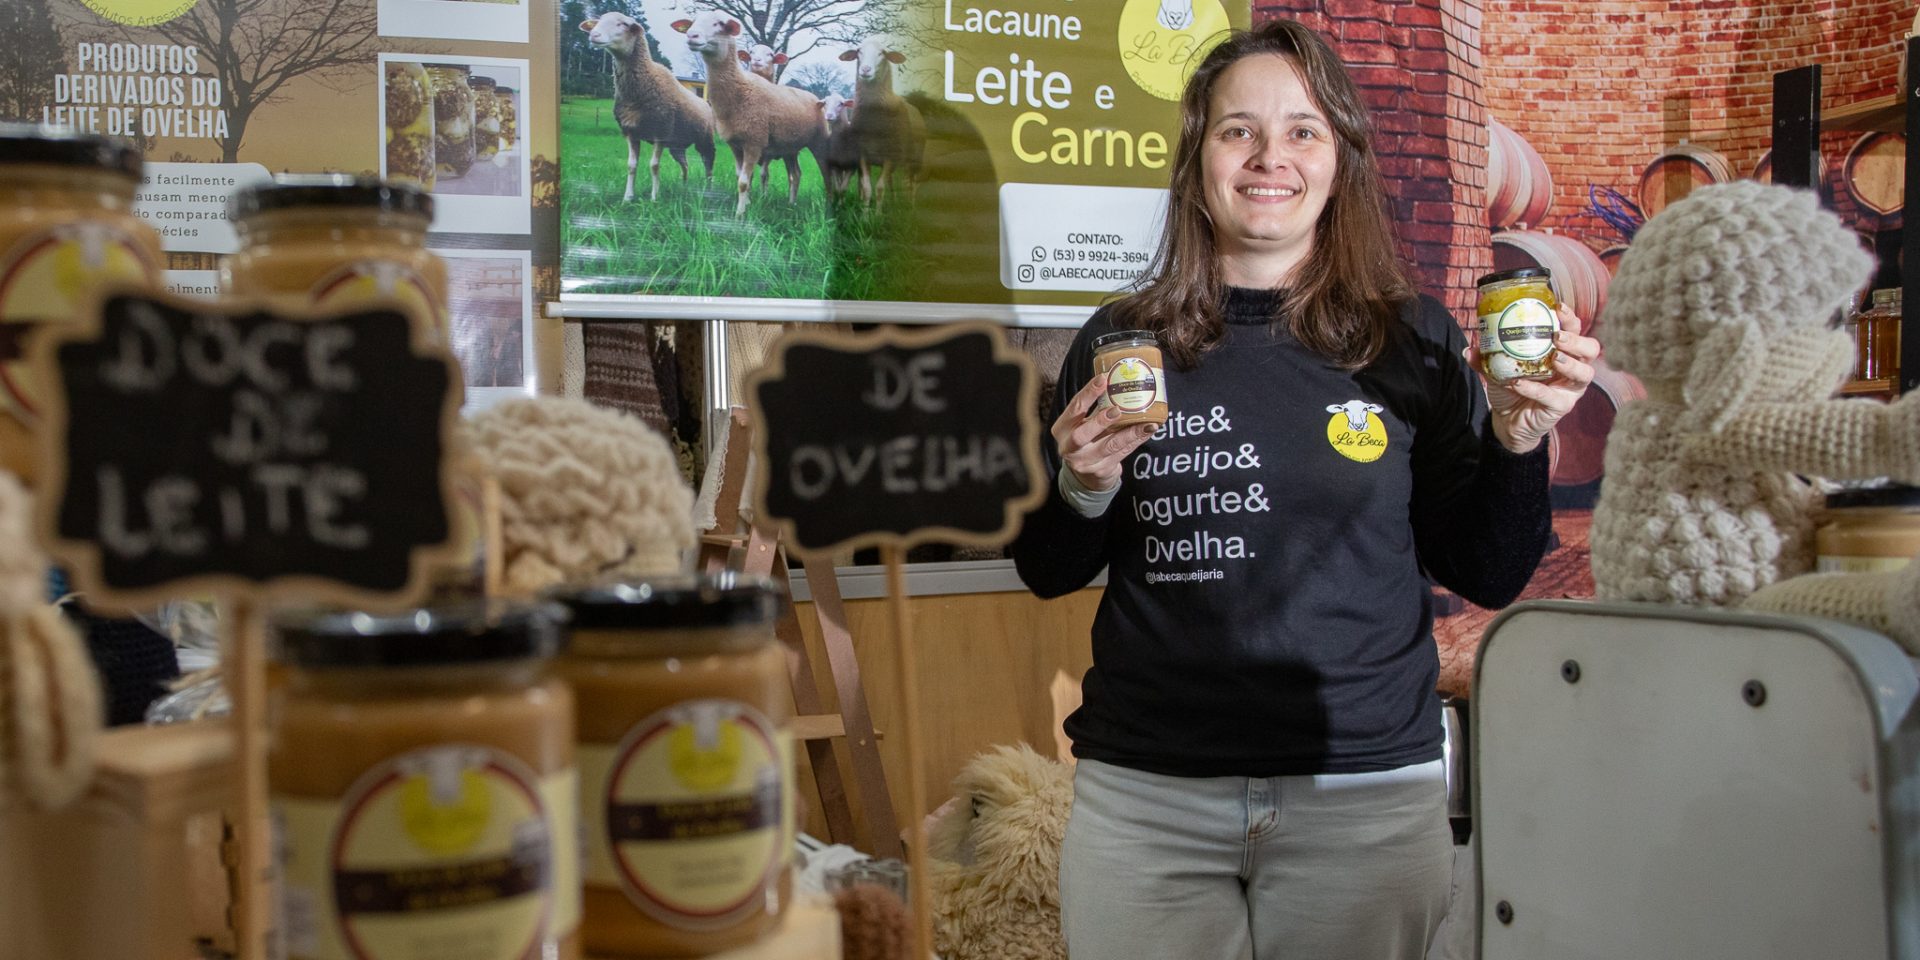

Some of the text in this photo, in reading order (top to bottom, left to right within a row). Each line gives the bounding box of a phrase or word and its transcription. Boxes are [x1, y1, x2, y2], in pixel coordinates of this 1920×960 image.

[944, 0, 1082, 40] Lacaune
[78, 42, 198, 75] PRODUTOS
[1123, 30, 1164, 63] La
[55, 74, 222, 107] DERIVADOS DO
[944, 50, 1115, 109] Leite e
[43, 105, 229, 138] LEITE DE OVELHA
[1011, 111, 1168, 169] Carne
[157, 174, 236, 186] facilmente
[136, 193, 182, 202] ausam
[133, 208, 228, 221] do comparad
[1053, 248, 1149, 263] (53) 9 9924-3694
[1067, 232, 1124, 246] CONTATO:
[104, 300, 358, 394] DOCE
[862, 350, 947, 412] DE
[212, 388, 328, 464] DE
[1151, 405, 1233, 441] eite&
[1332, 431, 1386, 447] La Beca
[788, 434, 1028, 498] OVELHA
[1133, 443, 1262, 479] Queijo&
[98, 460, 368, 558] LEITE
[1132, 483, 1271, 526] Iogurte&
[1145, 530, 1256, 563] Ovelha.
[1145, 568, 1224, 585] @labecaqueijaria
